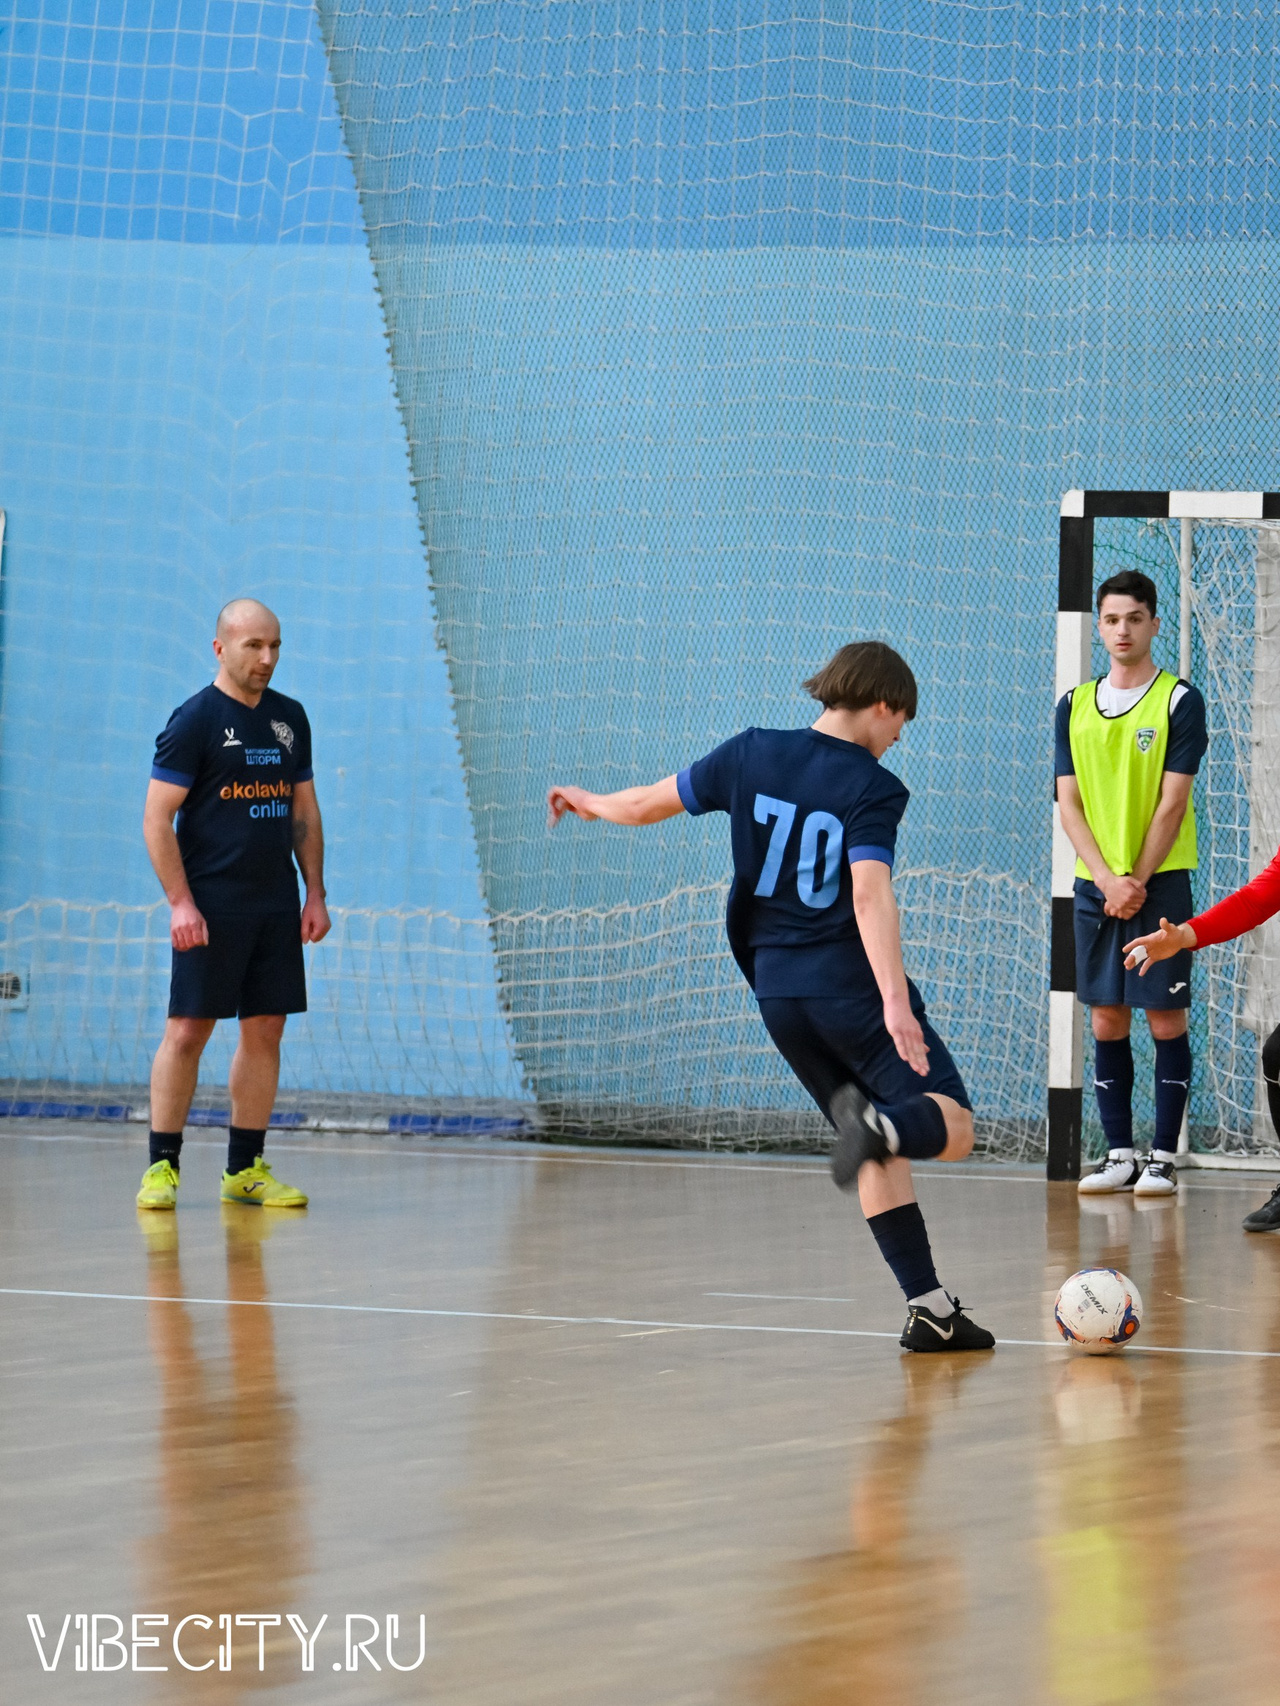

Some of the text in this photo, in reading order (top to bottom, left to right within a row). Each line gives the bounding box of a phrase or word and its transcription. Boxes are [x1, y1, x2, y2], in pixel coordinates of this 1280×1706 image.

[246, 755, 281, 765] ШТОРМ
[753, 793, 844, 909] 70
[1080, 1283, 1109, 1315] DEMIX
